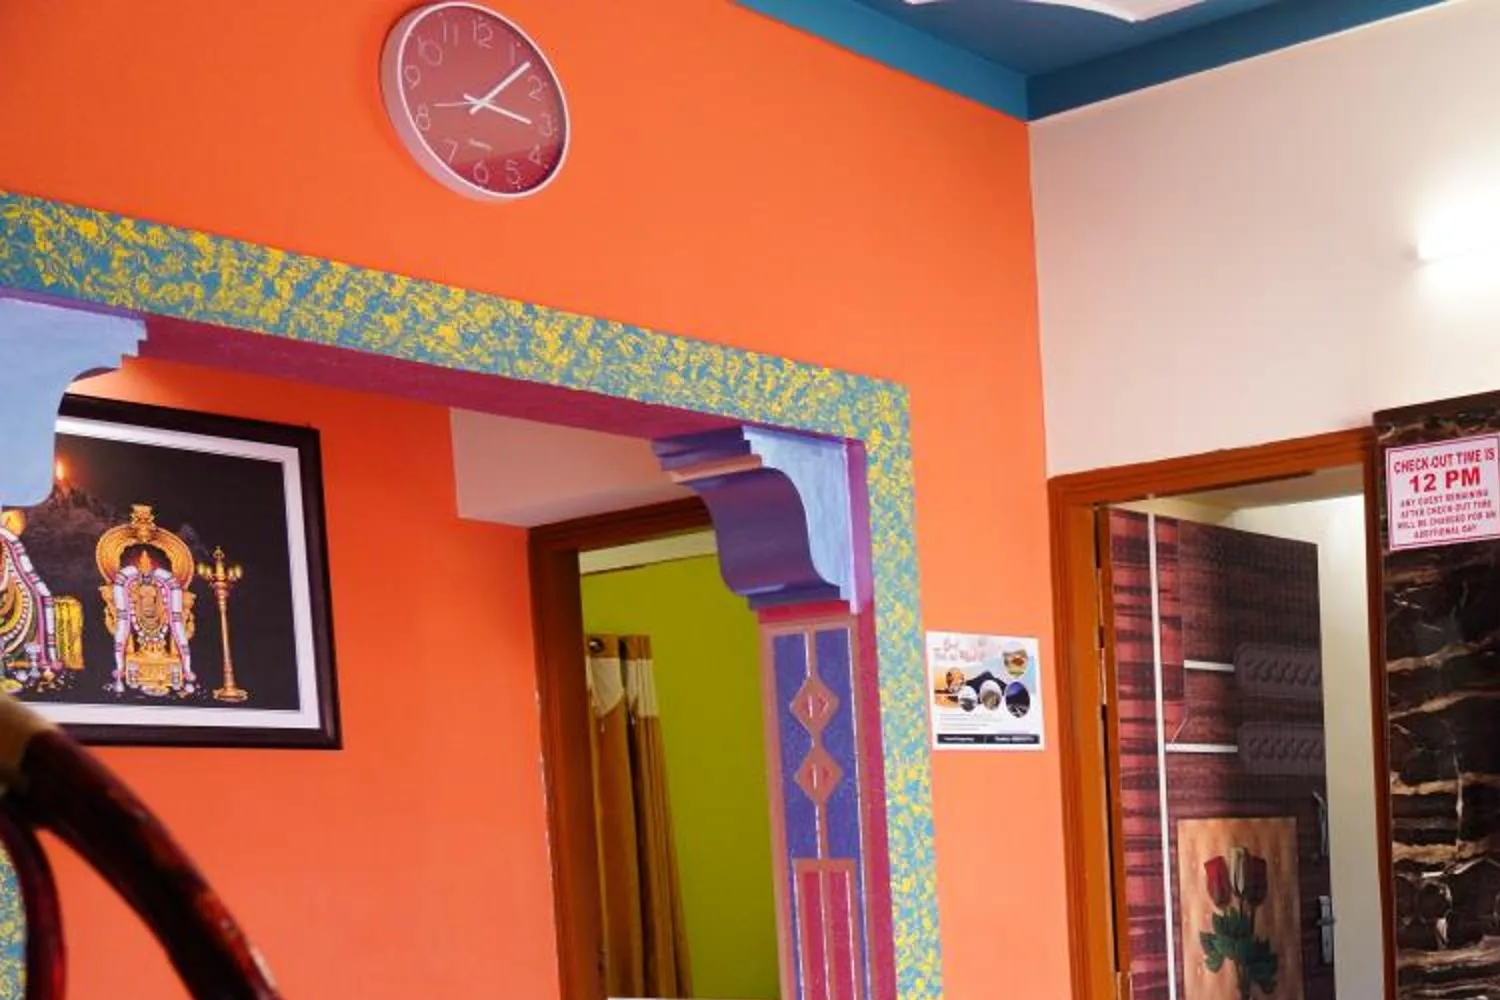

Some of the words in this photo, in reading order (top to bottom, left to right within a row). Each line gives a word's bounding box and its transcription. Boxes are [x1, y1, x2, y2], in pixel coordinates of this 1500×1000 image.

[443, 21, 459, 46] 11
[472, 17, 493, 49] 12
[417, 36, 443, 66] 10
[404, 64, 421, 90] 9
[527, 75, 543, 101] 2
[415, 103, 431, 131] 8
[539, 112, 553, 137] 3
[443, 138, 458, 162] 7
[528, 144, 542, 165] 4
[473, 159, 489, 184] 6
[505, 159, 522, 184] 5
[1393, 454, 1453, 474] CHECK-OUT
[1456, 449, 1481, 465] TIME
[1485, 447, 1495, 461] IS
[1409, 473, 1437, 493] 12
[1445, 467, 1480, 489] PM
